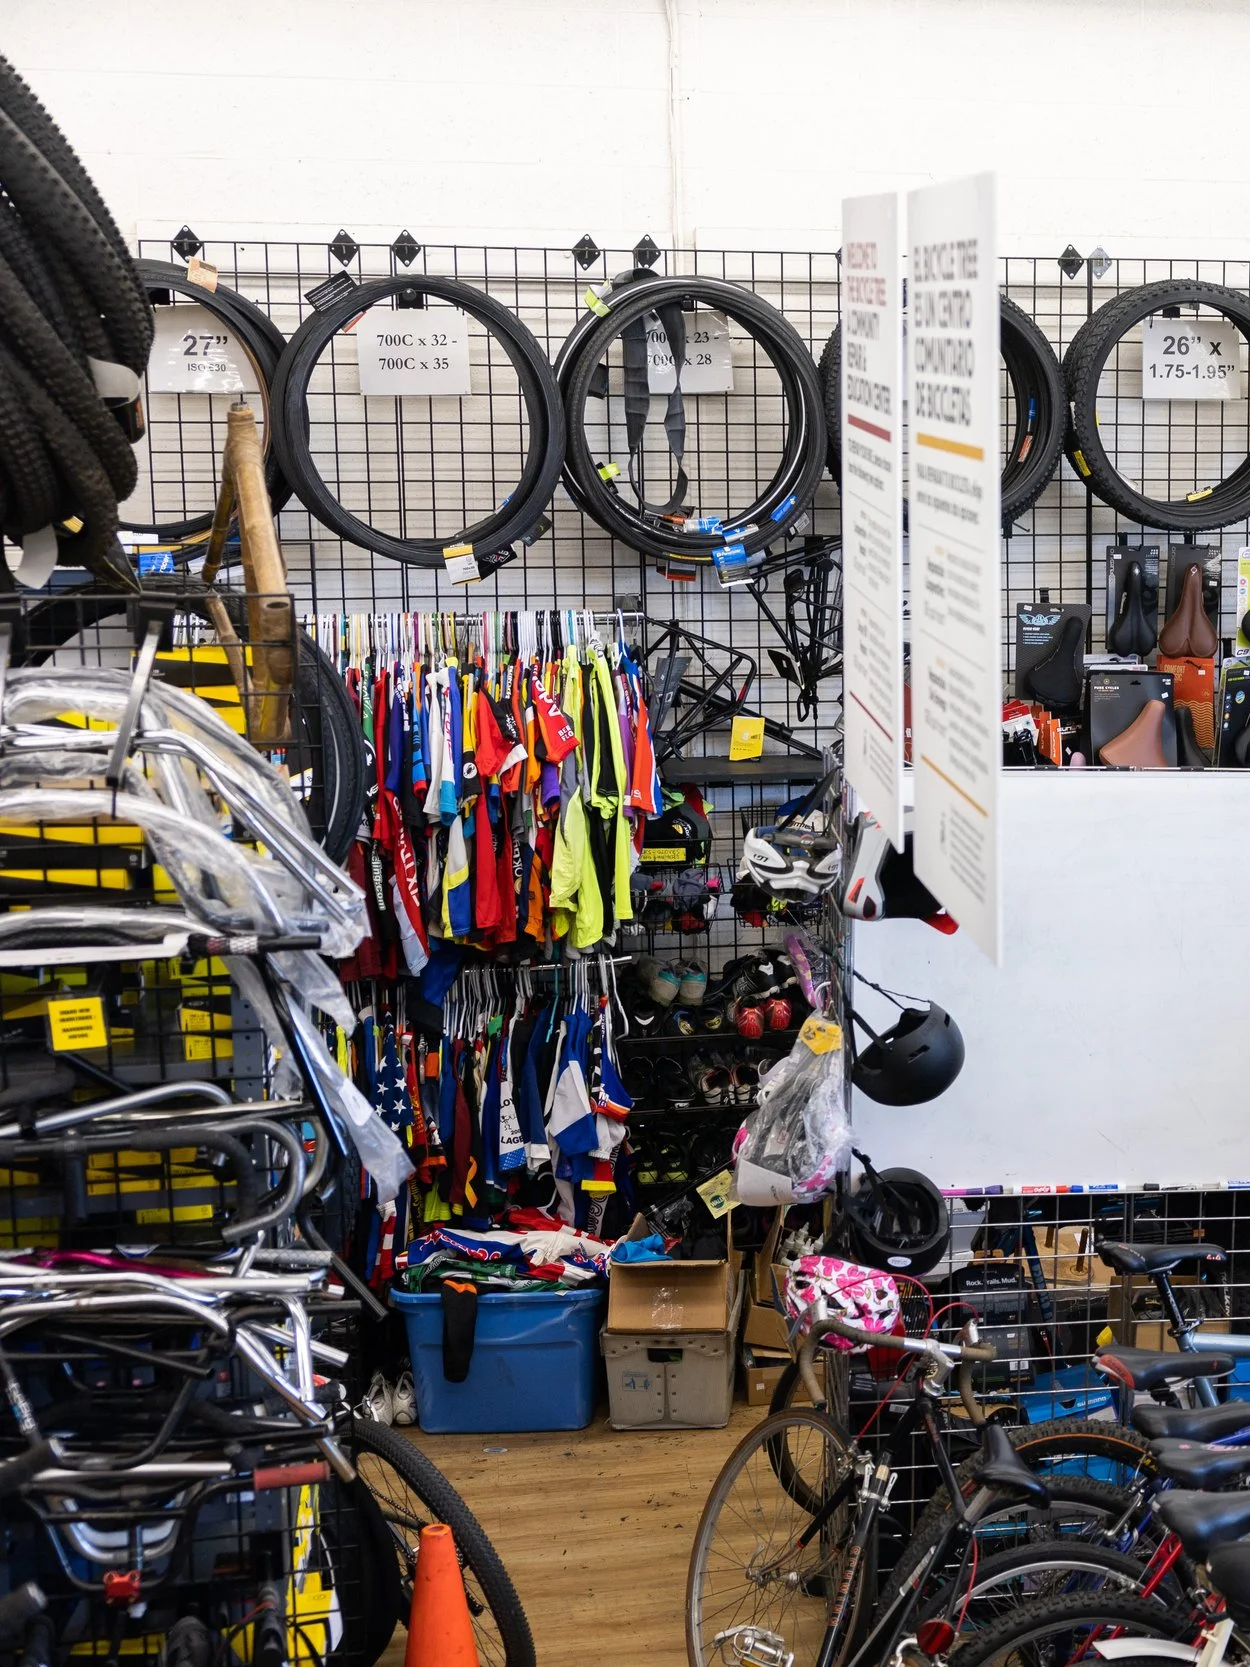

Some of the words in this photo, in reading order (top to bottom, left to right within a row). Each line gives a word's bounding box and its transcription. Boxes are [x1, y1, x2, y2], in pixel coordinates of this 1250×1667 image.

[376, 334, 413, 346] 700C
[418, 337, 427, 346] x
[431, 334, 448, 346] 32
[694, 331, 710, 344] 23
[1209, 342, 1222, 356] x
[378, 358, 416, 370] 700C
[420, 361, 429, 370] x
[433, 357, 449, 370] 35
[697, 354, 712, 365] 28
[1236, 648, 1249, 656] C9
[966, 1279, 984, 1287] Rock.
